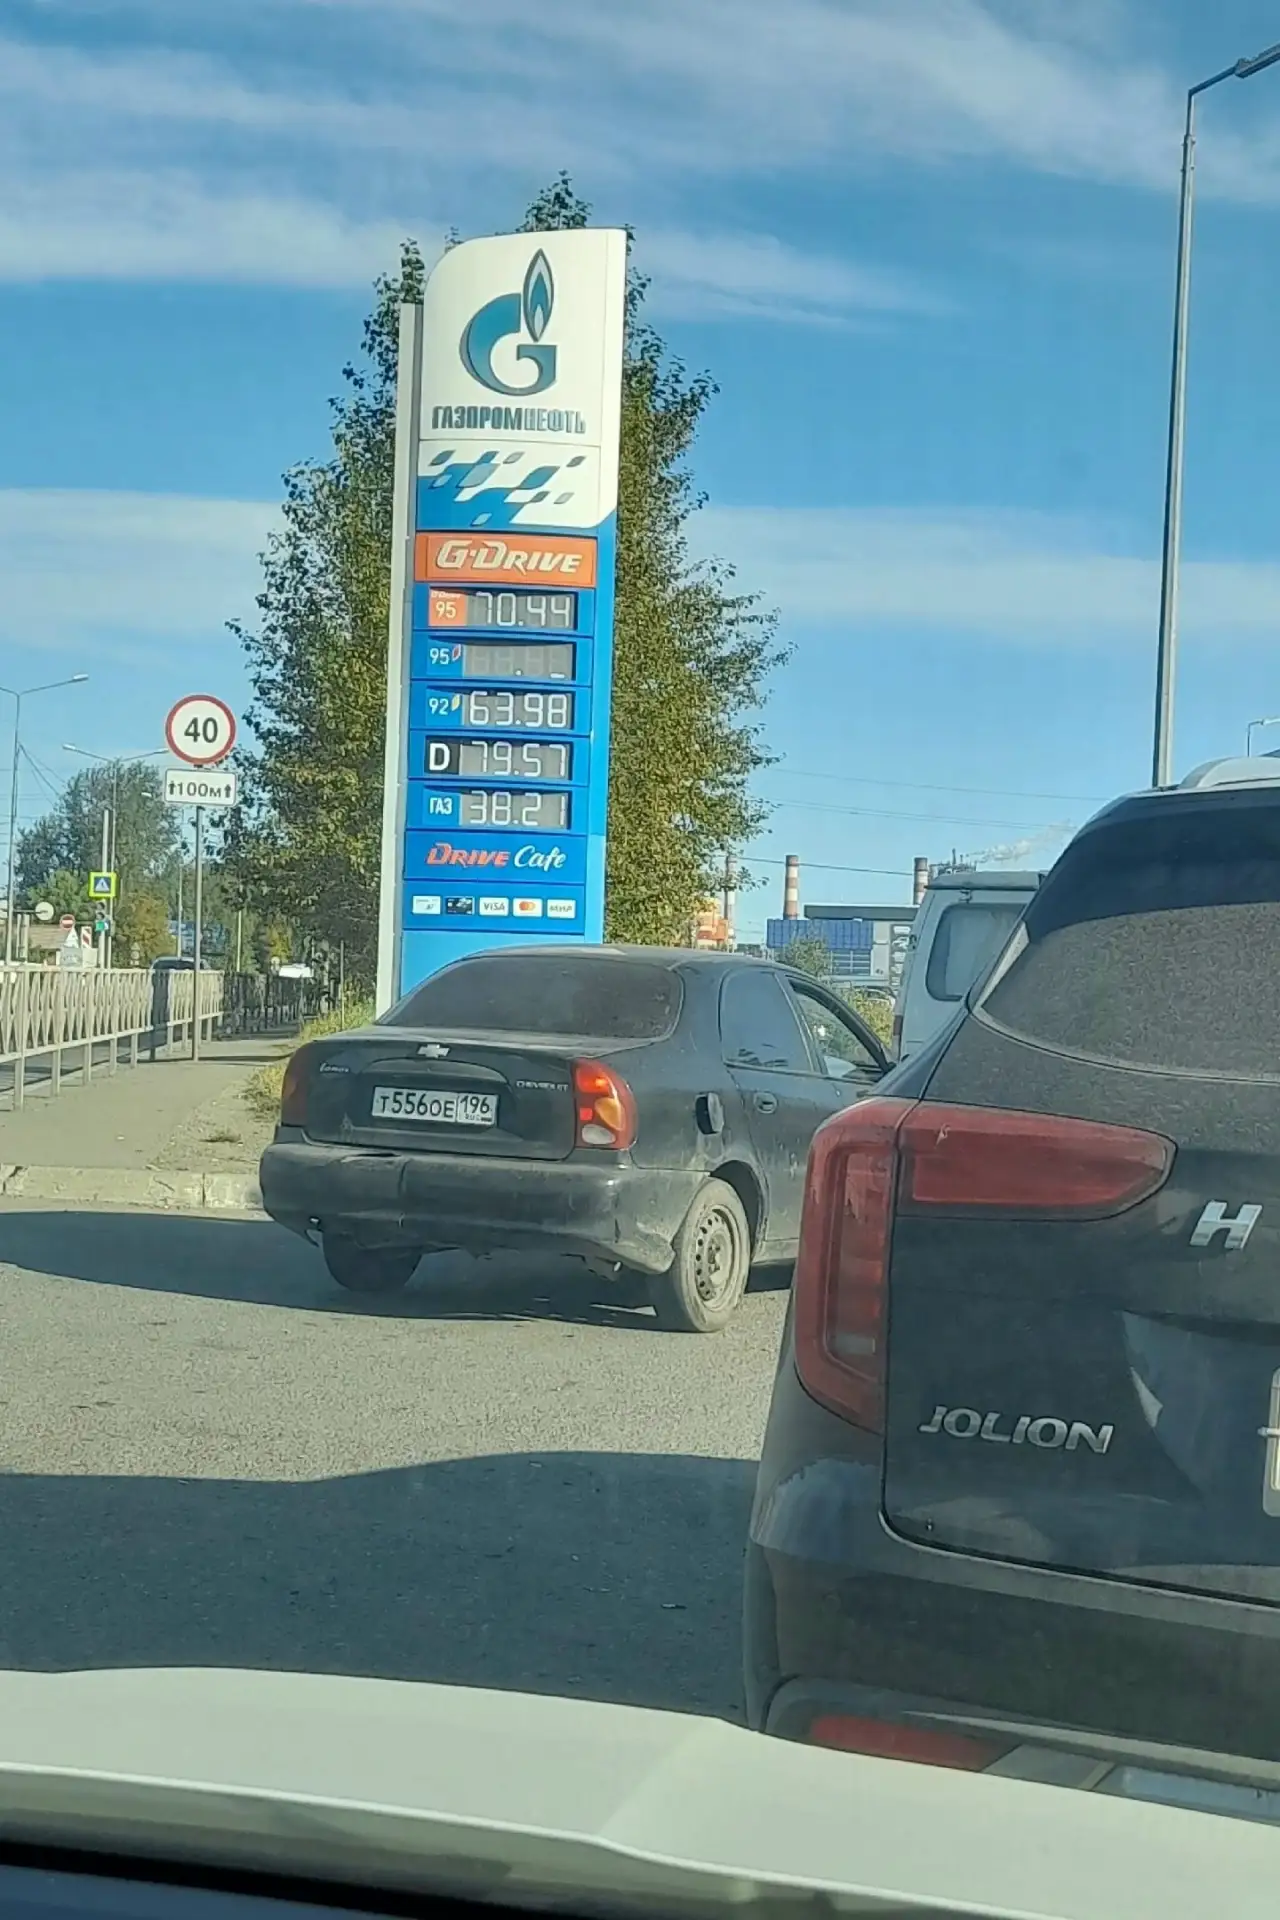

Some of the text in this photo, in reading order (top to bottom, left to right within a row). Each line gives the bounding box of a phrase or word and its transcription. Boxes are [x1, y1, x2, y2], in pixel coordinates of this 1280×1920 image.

[431, 405, 586, 434] ГАЗПРОМНЕФТЬ
[435, 591, 571, 627] 95 70.44
[429, 648, 450, 665] 95
[428, 691, 568, 728] 92 63.98
[184, 717, 219, 744] 40
[428, 741, 567, 777] D 79.57
[429, 790, 567, 826] ГАЗ 38.21
[483, 902, 506, 911] VISA
[918, 1404, 1115, 1454] JOLION
